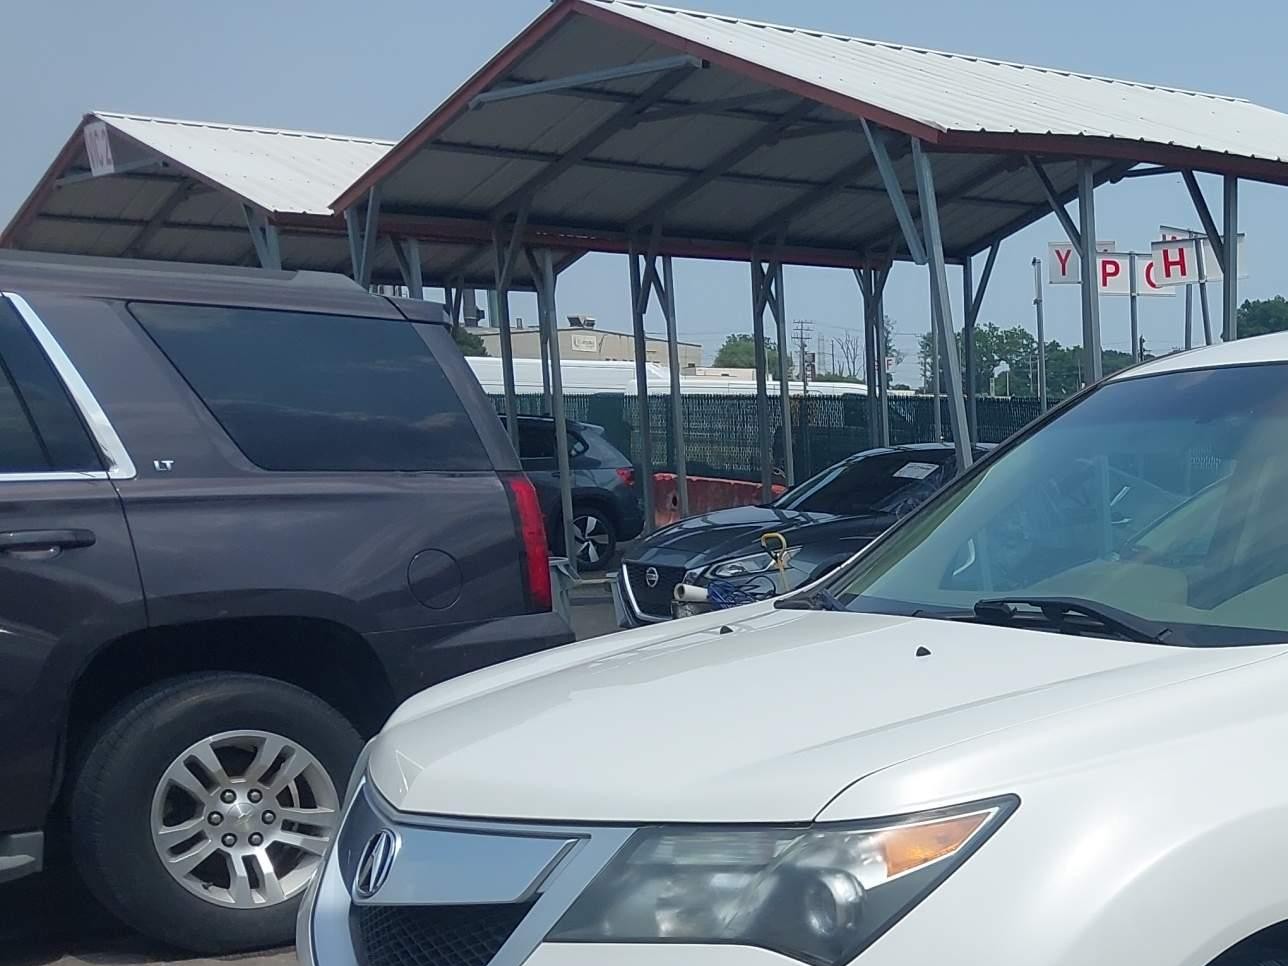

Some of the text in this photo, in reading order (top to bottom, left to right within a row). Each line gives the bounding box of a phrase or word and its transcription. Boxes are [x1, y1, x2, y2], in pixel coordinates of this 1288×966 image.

[1055, 249, 1072, 277] Y
[1101, 260, 1120, 288] P
[1162, 247, 1187, 279] H
[153, 460, 174, 471] LT
